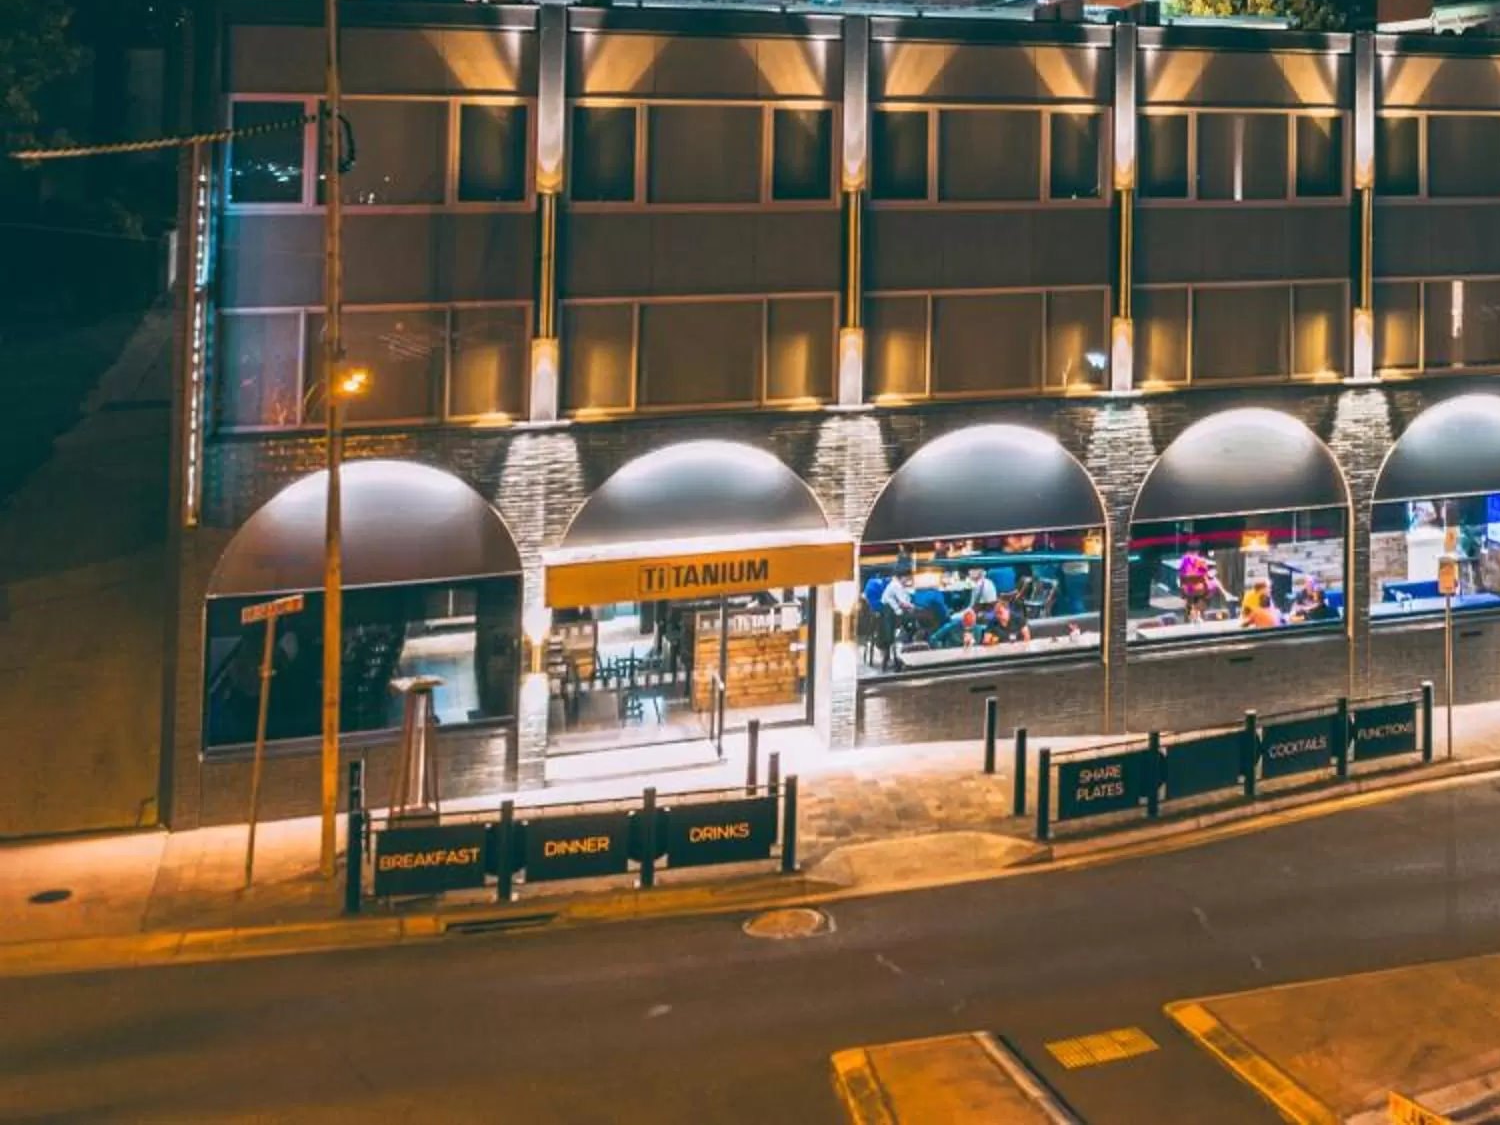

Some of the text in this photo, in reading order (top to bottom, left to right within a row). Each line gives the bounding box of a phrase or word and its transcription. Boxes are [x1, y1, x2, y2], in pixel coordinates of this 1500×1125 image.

[1268, 736, 1328, 758] COCKTAILS
[1079, 765, 1121, 783] SHARE
[1076, 782, 1124, 802] PLATES
[689, 822, 749, 843] DRINKS
[544, 836, 611, 857] DINNER
[379, 847, 480, 871] BREAKFAST
